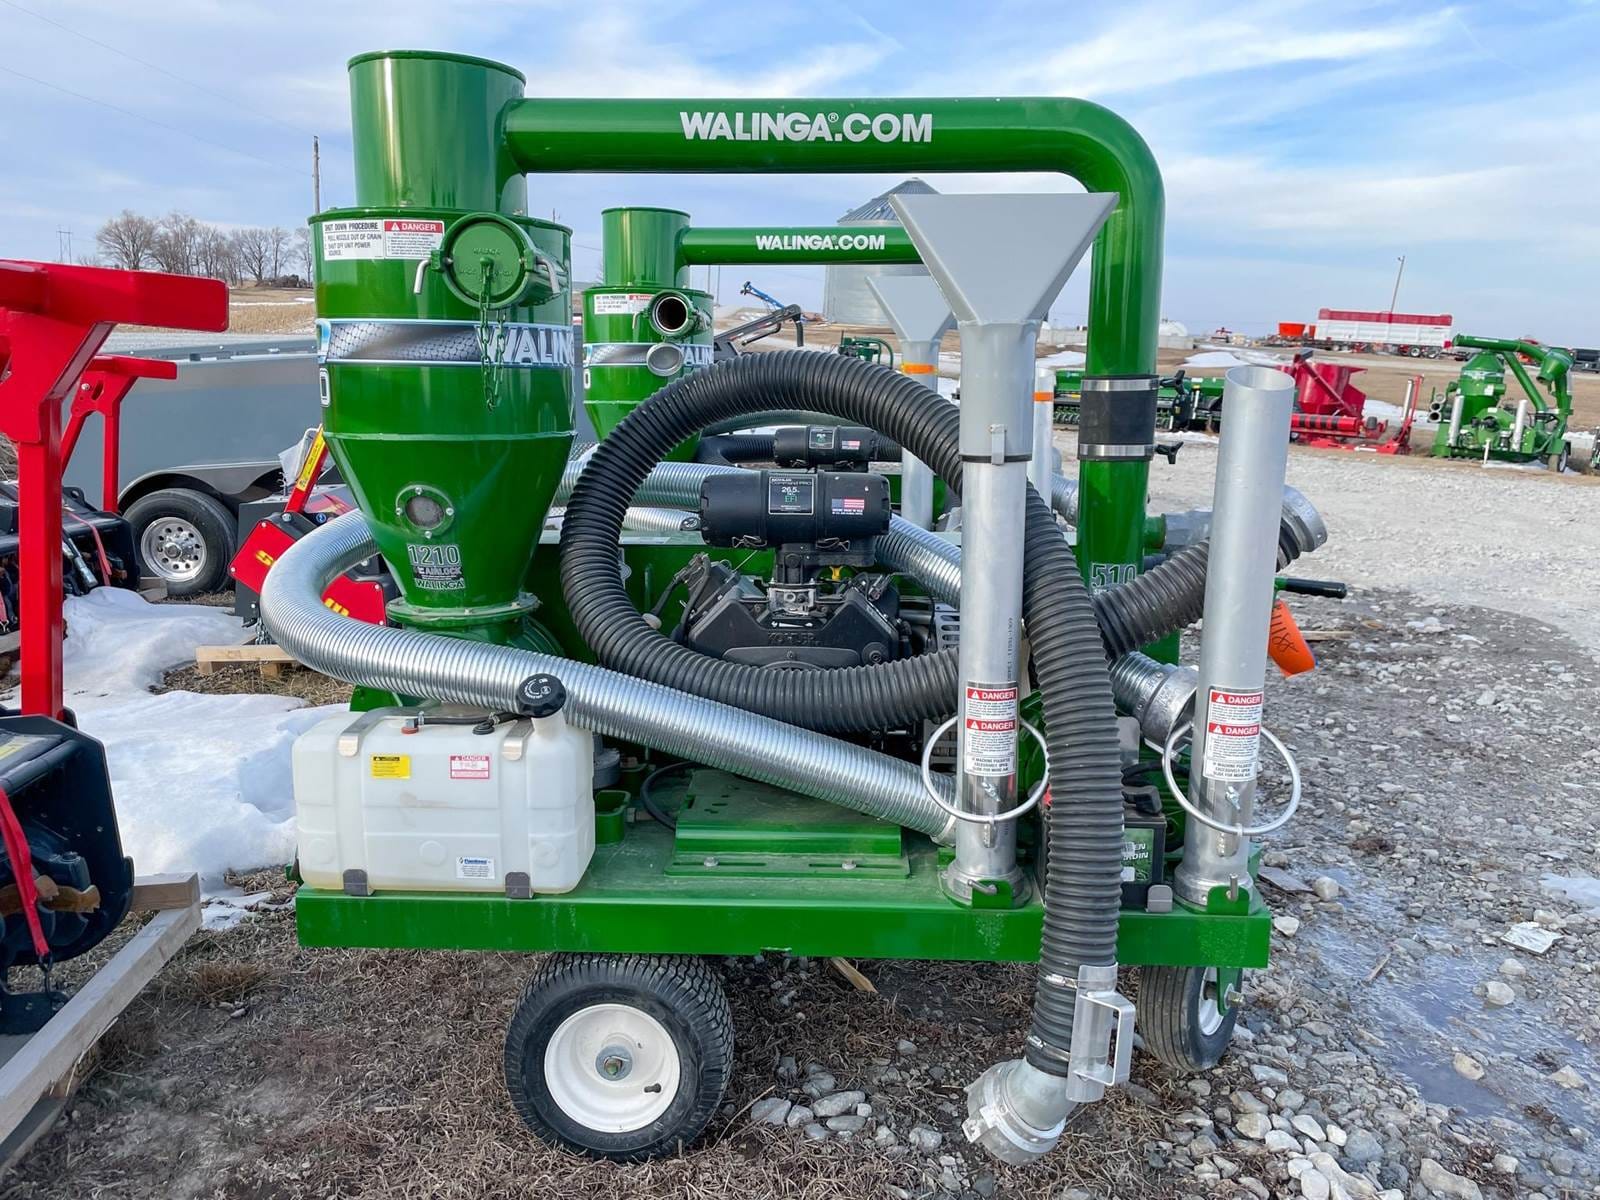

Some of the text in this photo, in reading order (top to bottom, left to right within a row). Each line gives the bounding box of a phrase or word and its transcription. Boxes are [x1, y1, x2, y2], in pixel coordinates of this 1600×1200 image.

[349, 222, 378, 230] PROCEDURE
[402, 223, 436, 231] DANGER
[407, 544, 461, 566] 1210
[414, 577, 466, 591] WALINGA
[981, 690, 1015, 700] DANGER
[1227, 695, 1261, 705] DANGER
[980, 721, 1014, 731] DANGER
[1225, 726, 1258, 736] DANGER
